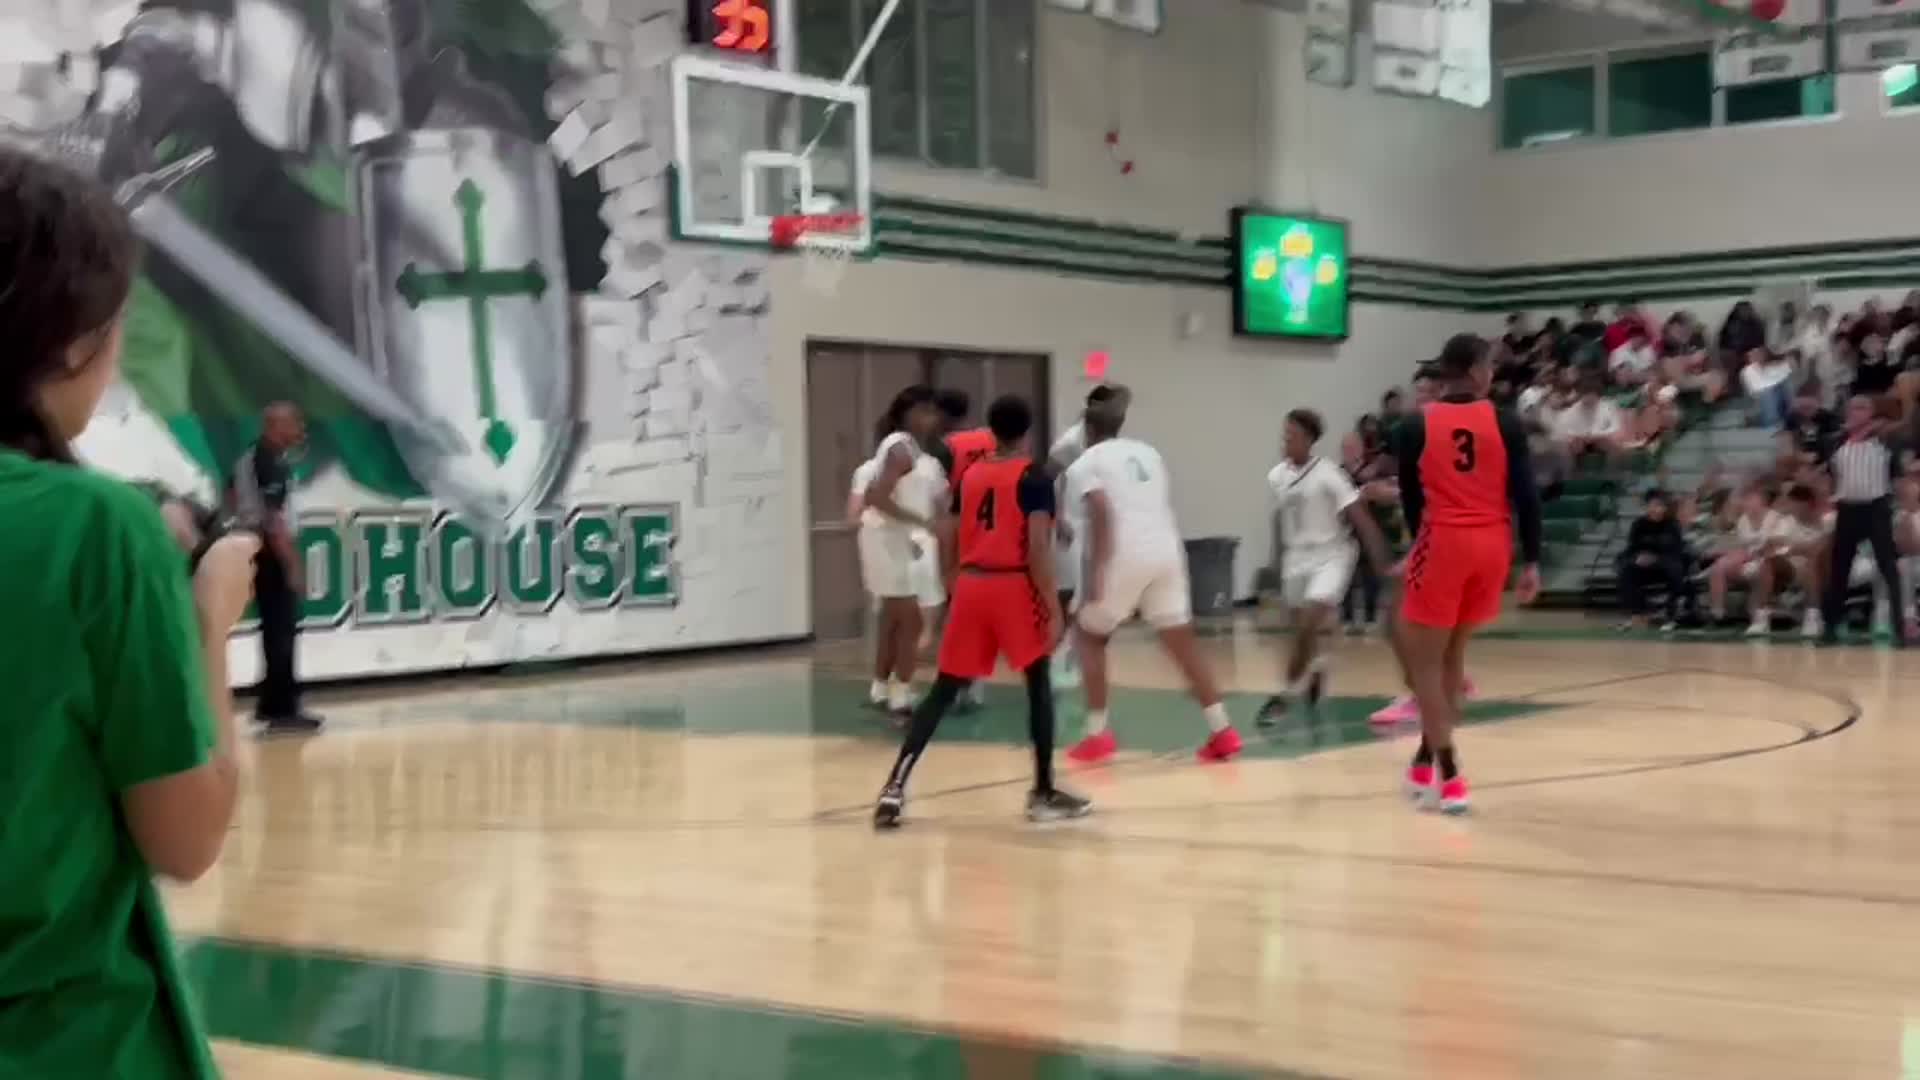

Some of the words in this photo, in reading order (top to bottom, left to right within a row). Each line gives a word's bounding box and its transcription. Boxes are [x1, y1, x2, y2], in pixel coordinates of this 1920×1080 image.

[1451, 428, 1475, 473] 3
[976, 487, 996, 531] 4
[240, 506, 679, 626] DHOUSE
